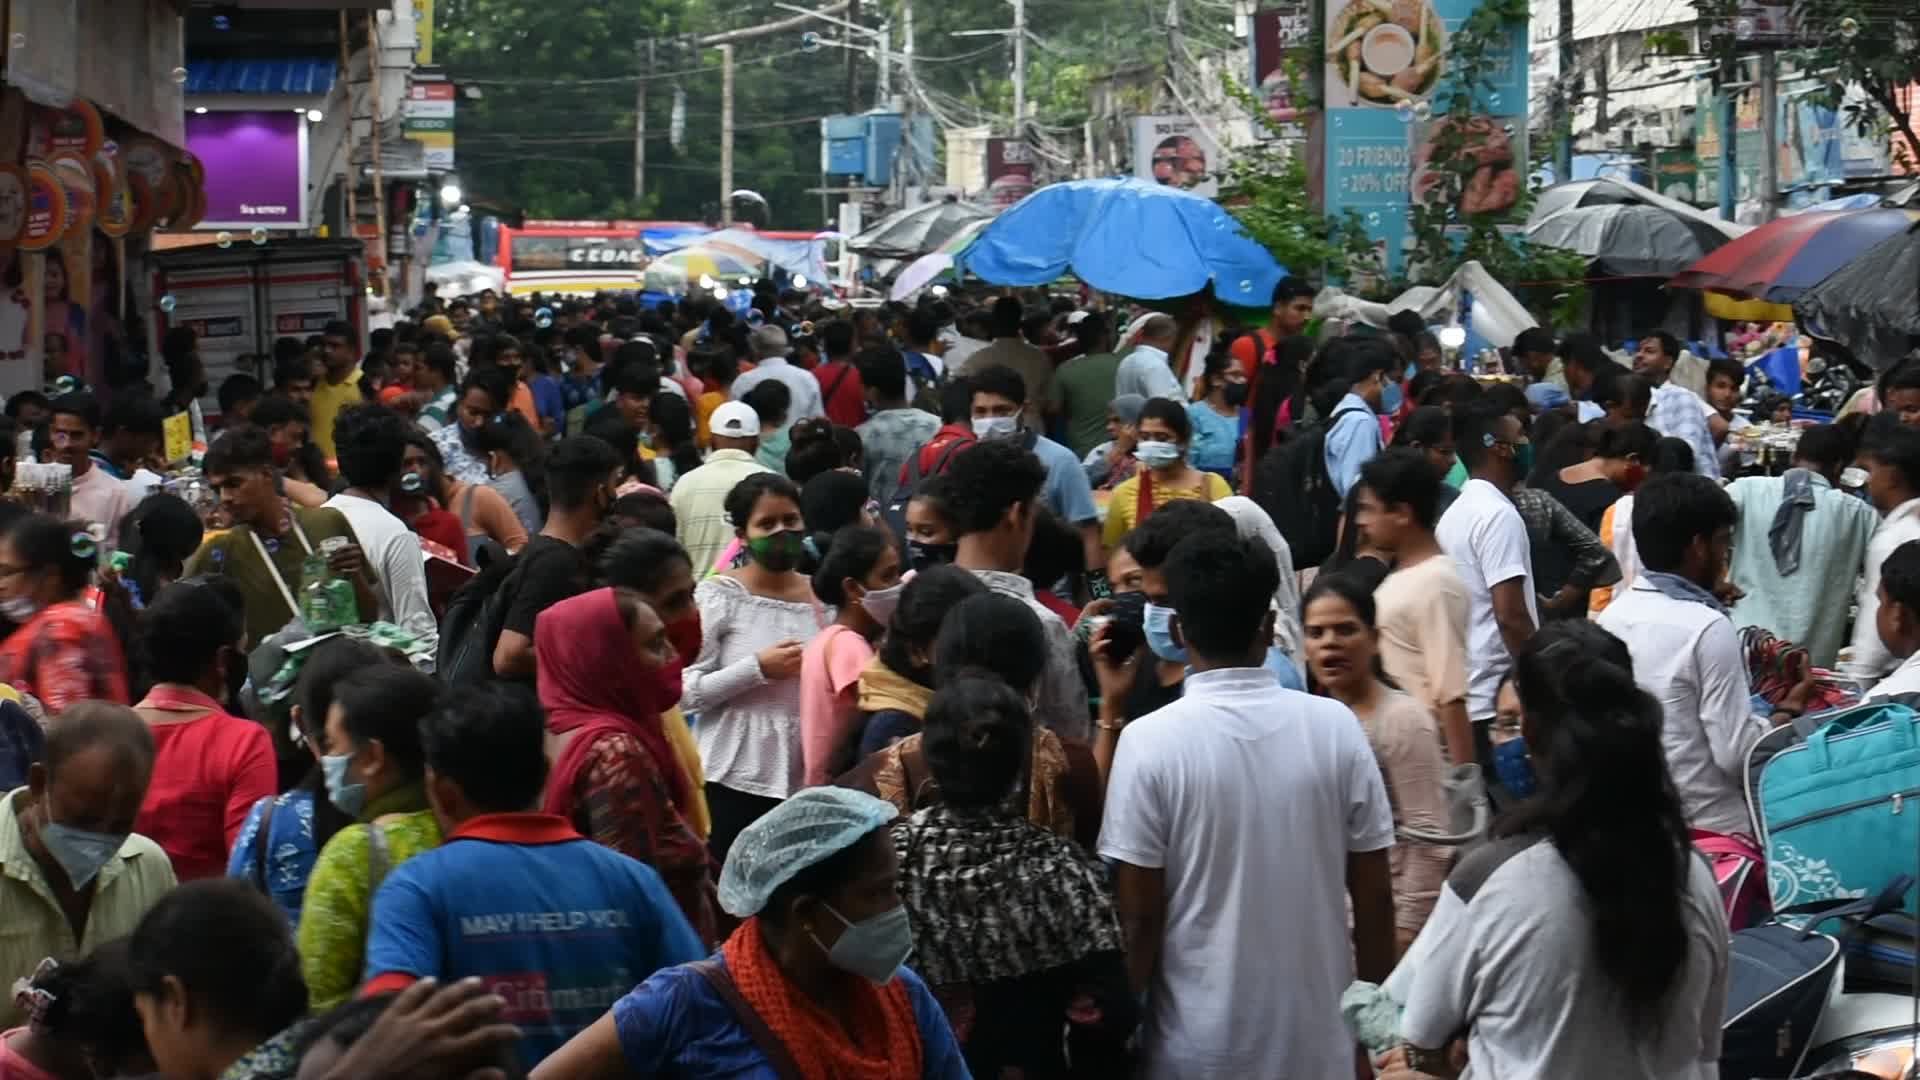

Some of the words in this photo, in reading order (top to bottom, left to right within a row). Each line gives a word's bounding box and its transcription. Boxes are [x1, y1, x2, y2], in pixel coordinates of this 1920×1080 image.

[1356, 146, 1409, 167] FRIENDS
[1383, 173, 1408, 193] OFF
[460, 916, 513, 936] MAY
[525, 910, 586, 932] HELP
